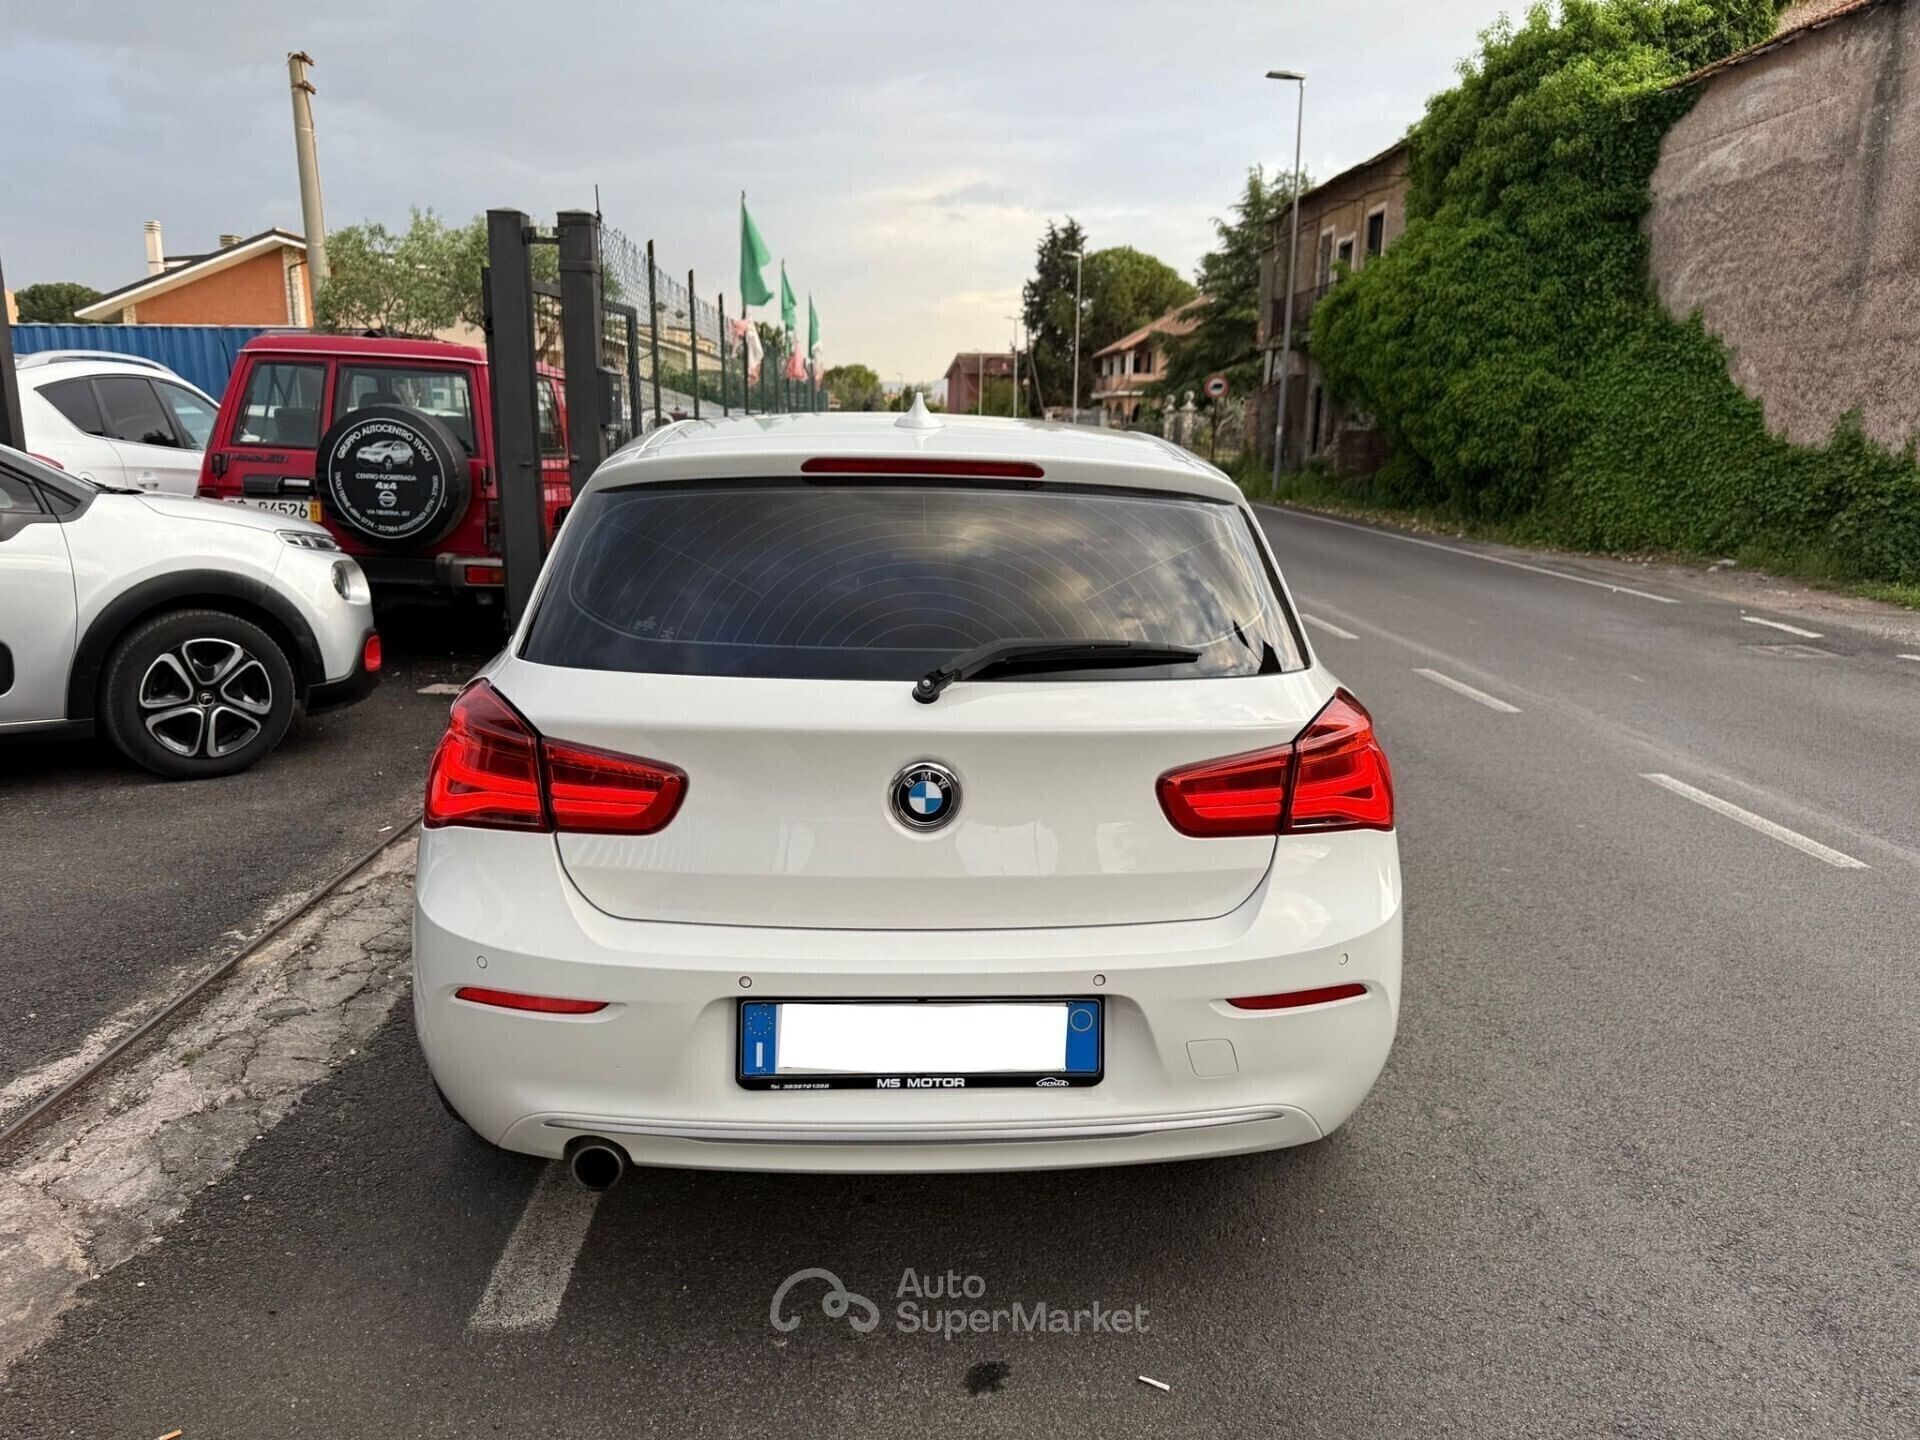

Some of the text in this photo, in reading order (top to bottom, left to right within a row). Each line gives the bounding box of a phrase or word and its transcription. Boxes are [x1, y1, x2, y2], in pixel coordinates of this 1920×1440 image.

[337, 424, 433, 462] GRUPPO AUTOCENTRO TIVOLI
[355, 472, 379, 480] CENTRO
[375, 481, 397, 490] 4x4
[904, 772, 949, 789] BMW
[876, 1078, 901, 1089] MS
[907, 1077, 966, 1088] MOTOR
